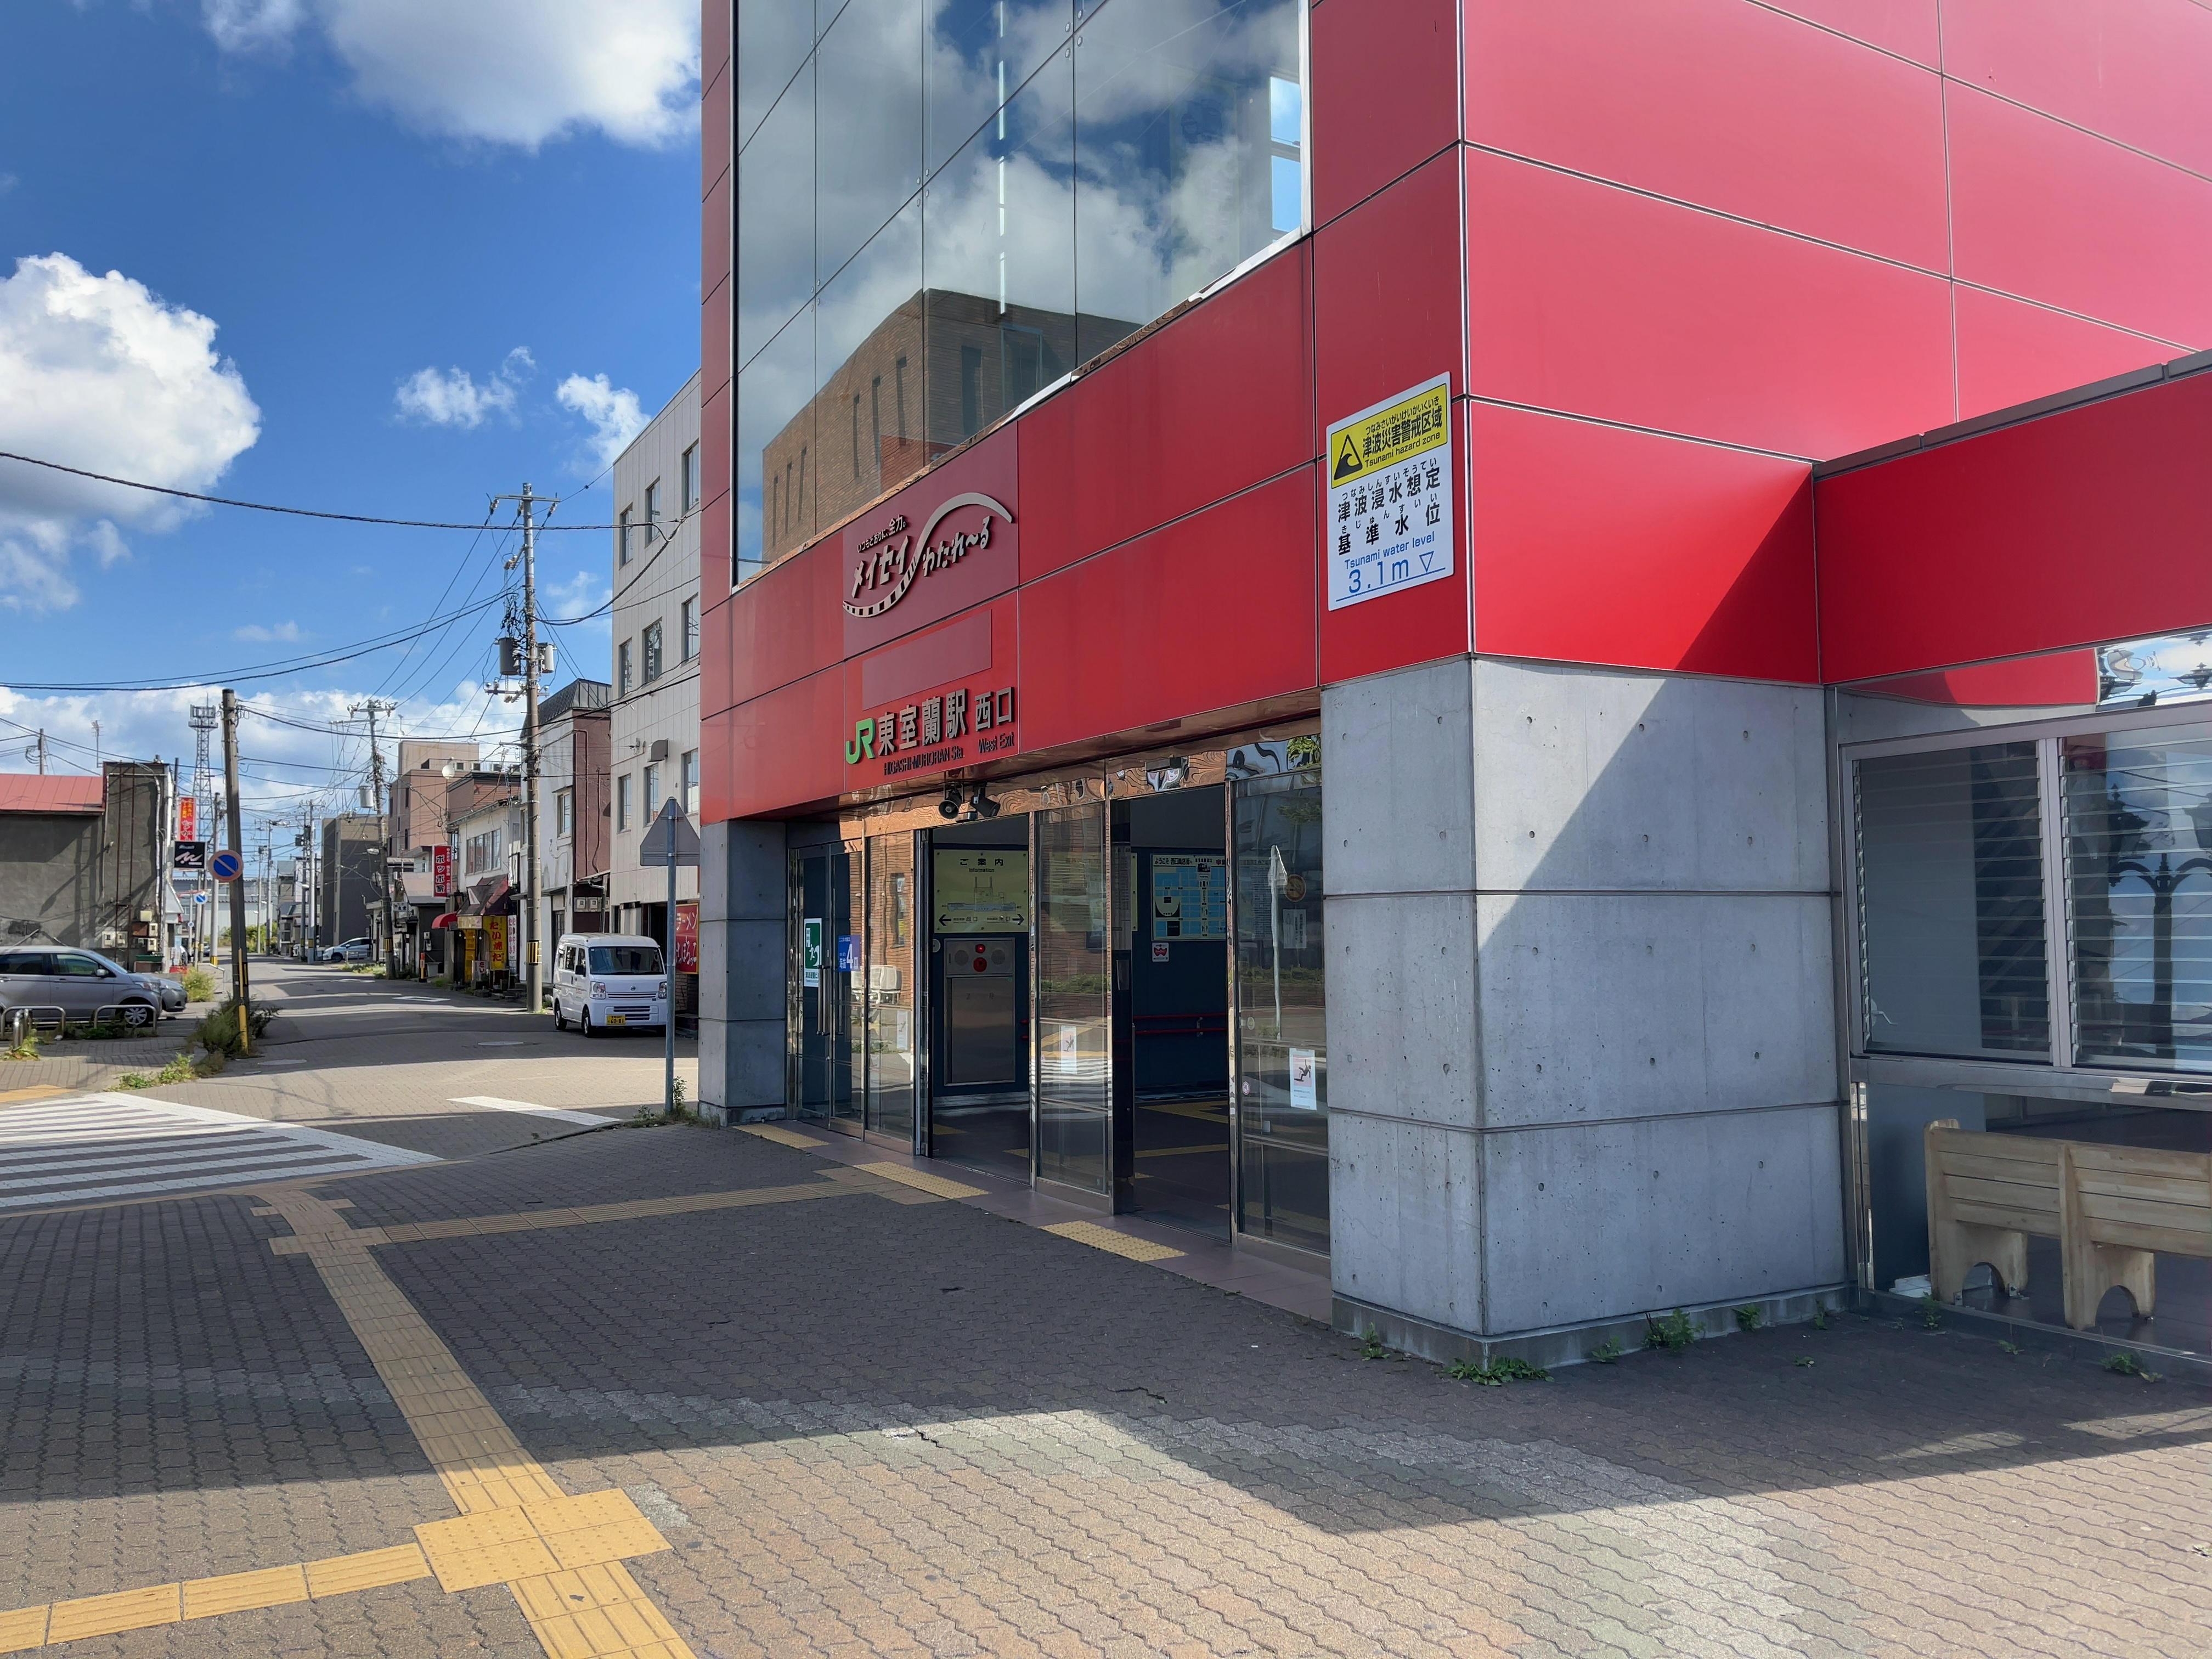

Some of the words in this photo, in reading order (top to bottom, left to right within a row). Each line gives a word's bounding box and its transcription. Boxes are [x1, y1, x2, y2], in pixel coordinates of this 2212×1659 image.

[1363, 405, 1442, 458] 津波災害警戒区域
[1365, 396, 1440, 435] つなみさいがいけいかいくいき
[1365, 449, 1394, 467] Tsunami
[1396, 438, 1420, 455] hazard
[1422, 432, 1441, 445] zone
[1338, 467, 1441, 523] 津波浸水想定
[1342, 458, 1437, 501] つなみしんすいそうてい
[1339, 502, 1441, 556] 基準水位
[1345, 549, 1380, 570] Tsunami
[1383, 541, 1409, 557] water
[1412, 531, 1435, 548] level
[845, 718, 876, 764] JR
[878, 688, 968, 756] 東室蘭駅
[974, 686, 1014, 732] 西口
[978, 736, 997, 754] West
[999, 731, 1015, 748] Exit
[960, 858, 1003, 866] ご案内
